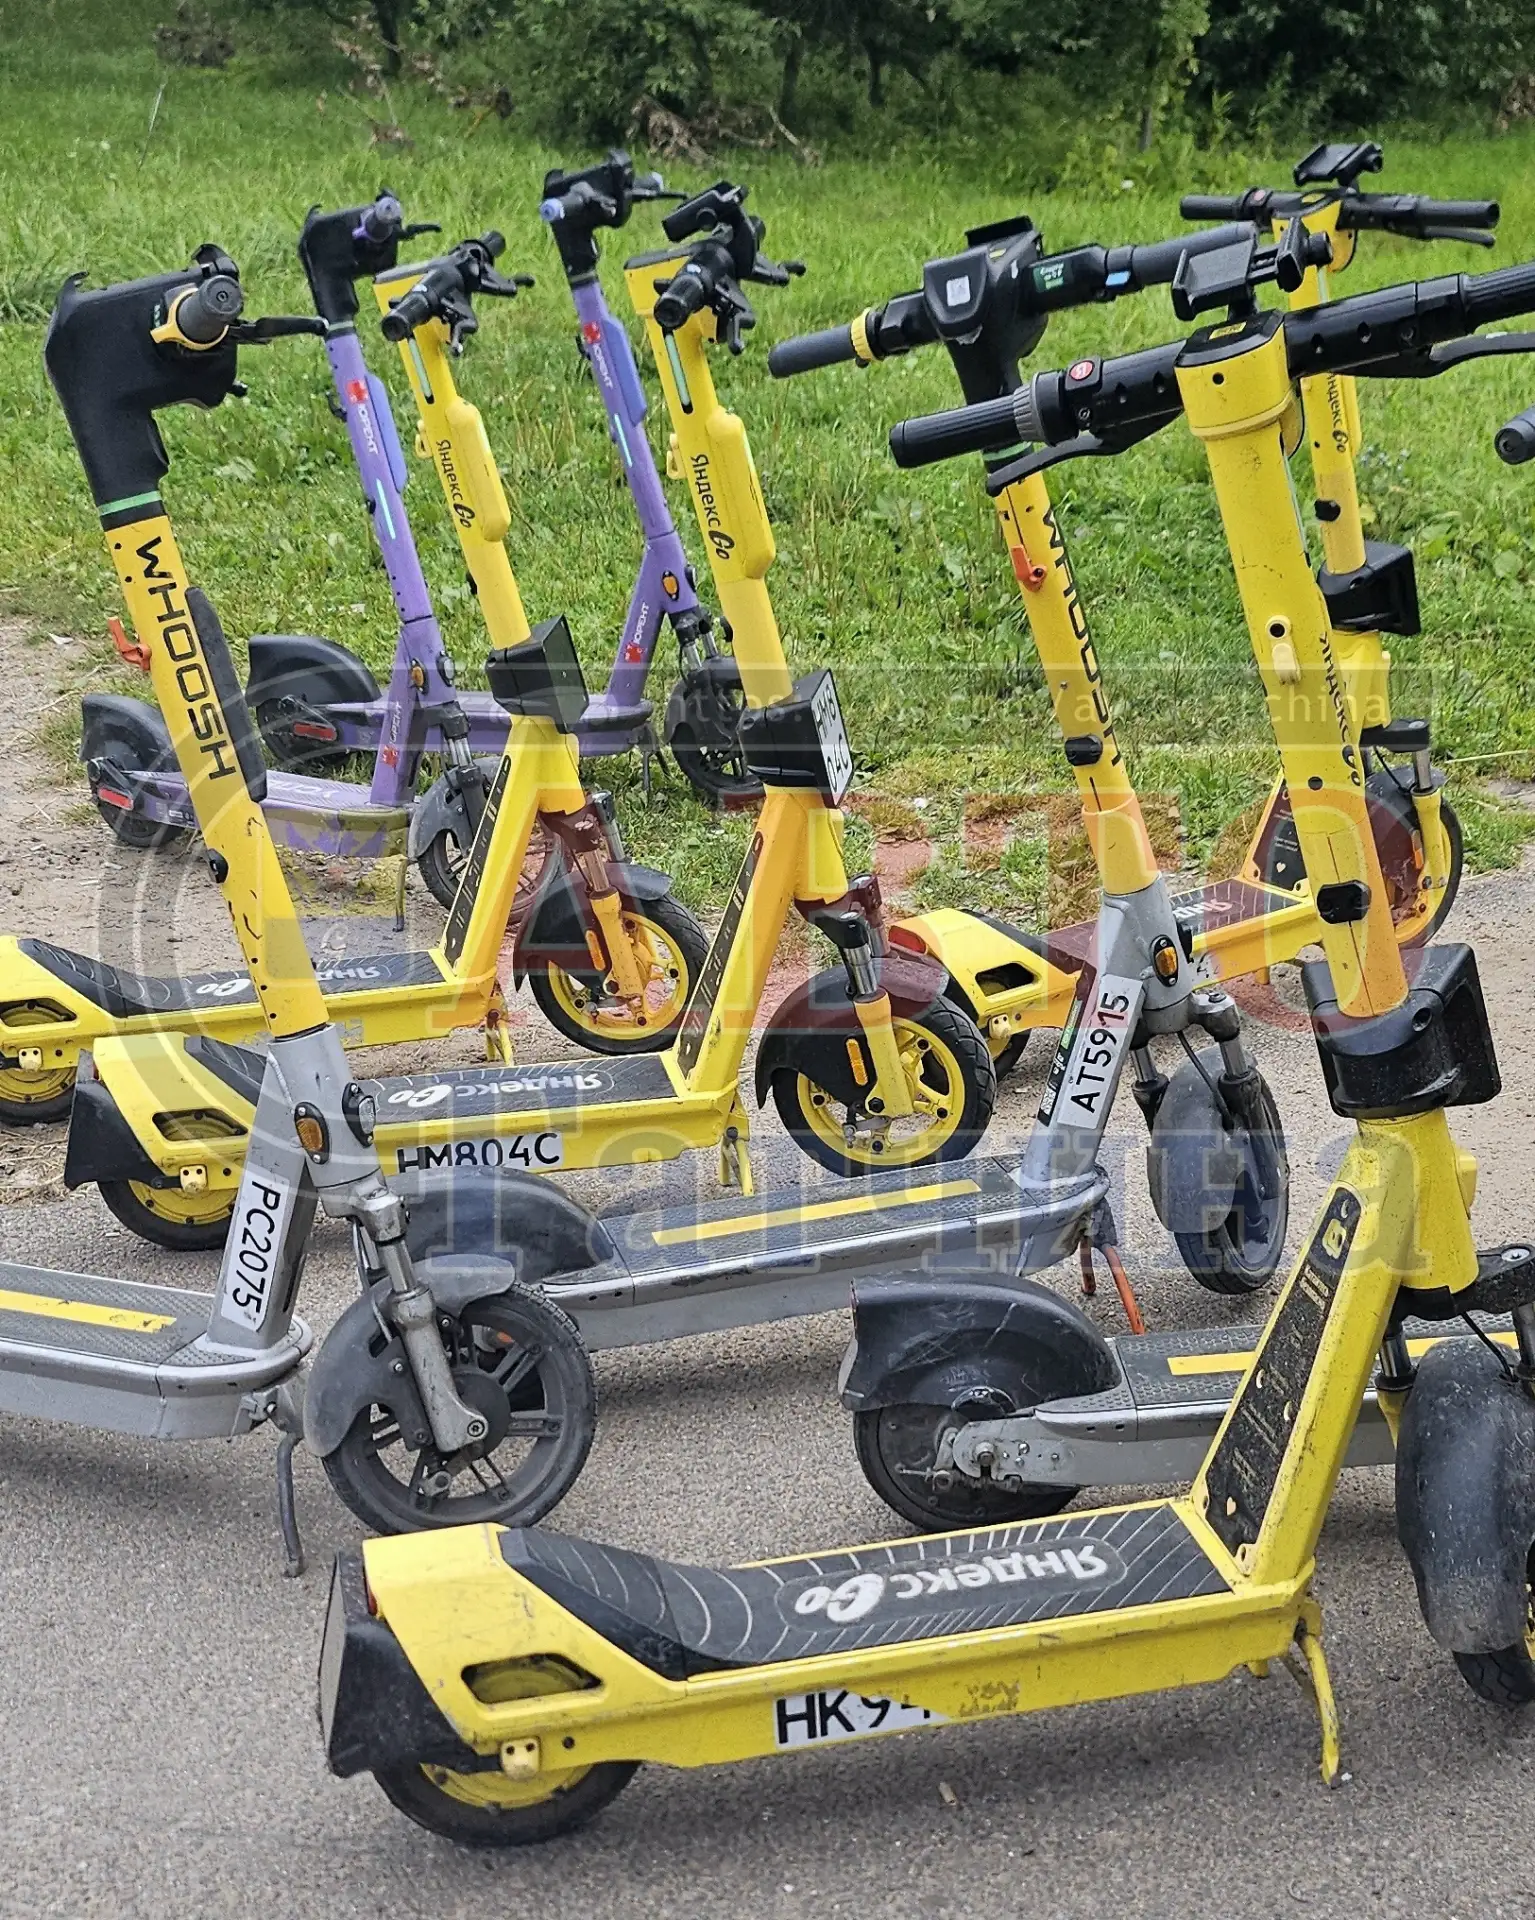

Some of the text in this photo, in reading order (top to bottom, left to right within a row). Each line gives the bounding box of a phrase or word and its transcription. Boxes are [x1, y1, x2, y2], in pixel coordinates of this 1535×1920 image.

[1332, 430, 1347, 454] Go
[436, 439, 475, 529] Яндекс Go
[691, 454, 730, 560] Яндекс Go
[136, 536, 236, 780] WHOOSH
[196, 977, 251, 997] Go
[388, 1073, 602, 1107] Яндекс Go
[794, 1545, 1107, 1623] Яндекс Go
